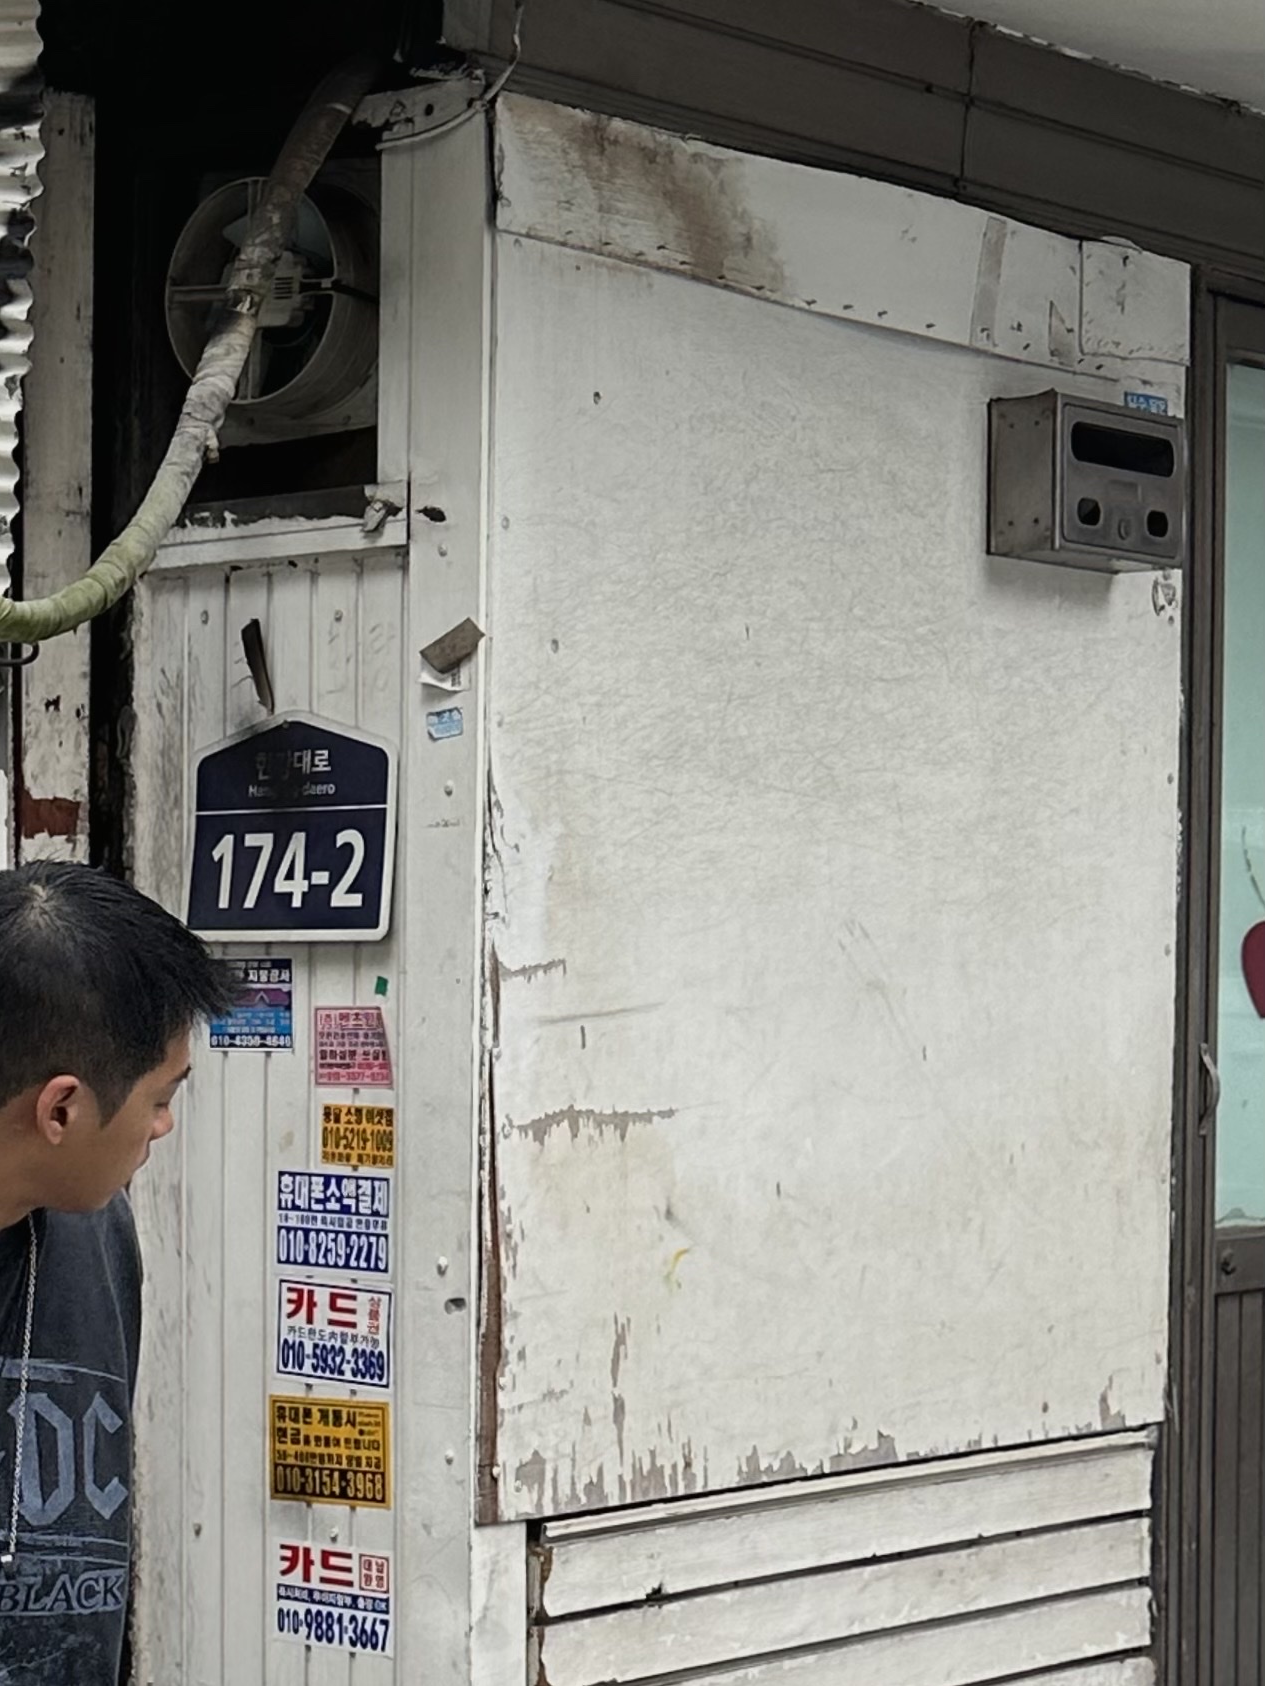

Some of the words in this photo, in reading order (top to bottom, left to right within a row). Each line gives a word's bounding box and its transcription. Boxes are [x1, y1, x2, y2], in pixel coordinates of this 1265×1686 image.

[255, 748, 332, 781] 한대로
[211, 828, 365, 909] 174-2
[280, 1173, 388, 1215] 휴대폰소액결제
